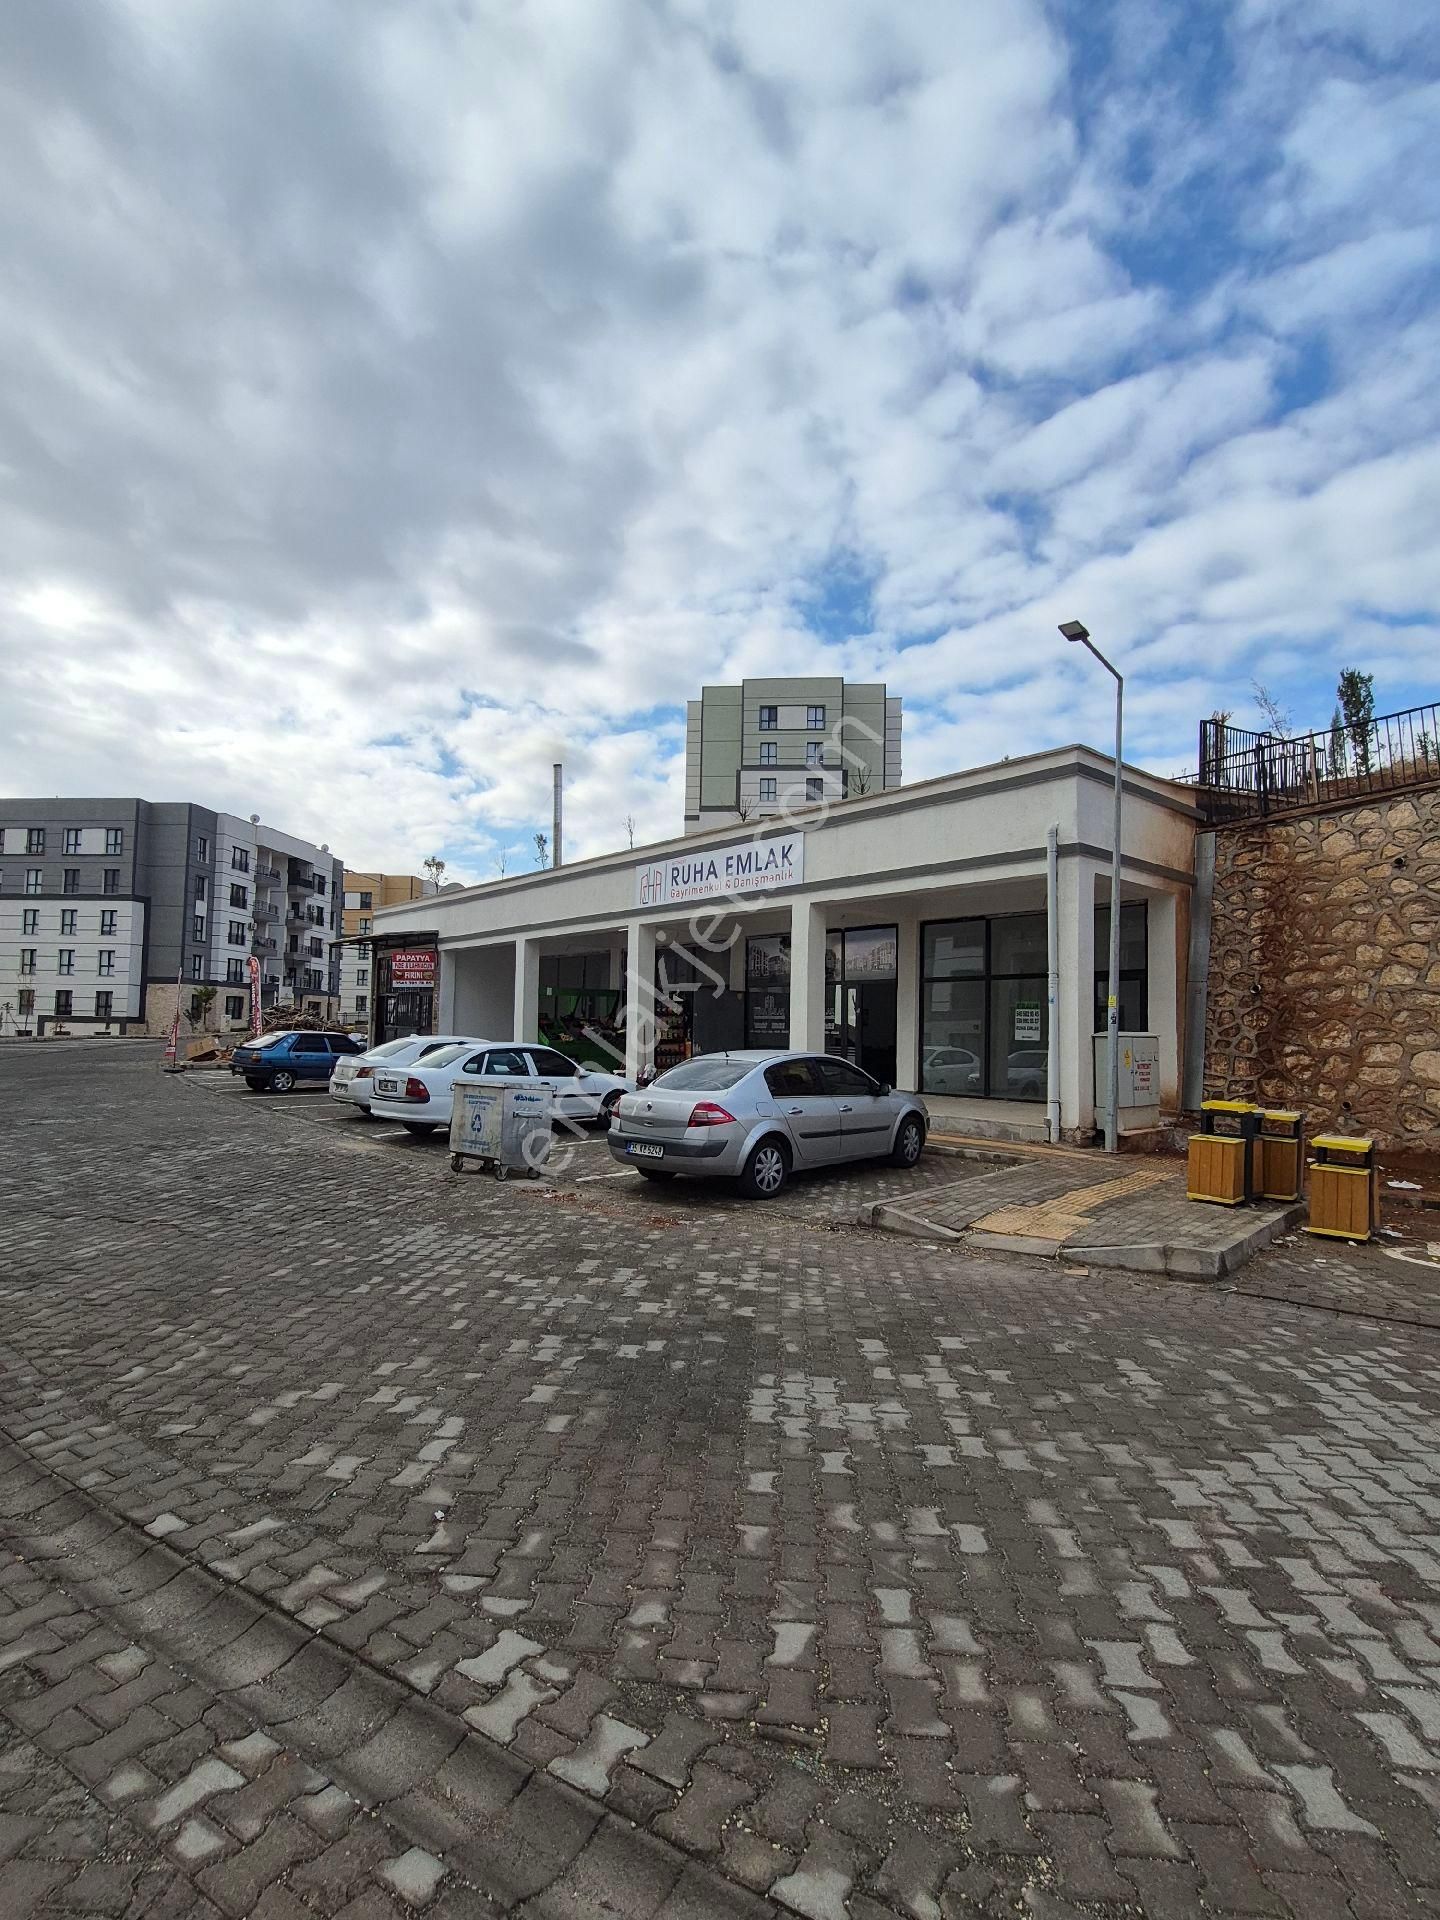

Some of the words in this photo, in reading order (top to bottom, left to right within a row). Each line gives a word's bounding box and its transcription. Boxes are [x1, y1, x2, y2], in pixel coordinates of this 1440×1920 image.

[671, 859, 718, 887] RUHA
[725, 843, 793, 877] EMLAK
[670, 881, 722, 900] Gayrimenkul
[725, 879, 731, 889] &
[733, 869, 793, 888] Danışmanlık
[396, 954, 430, 962] PAPATYA
